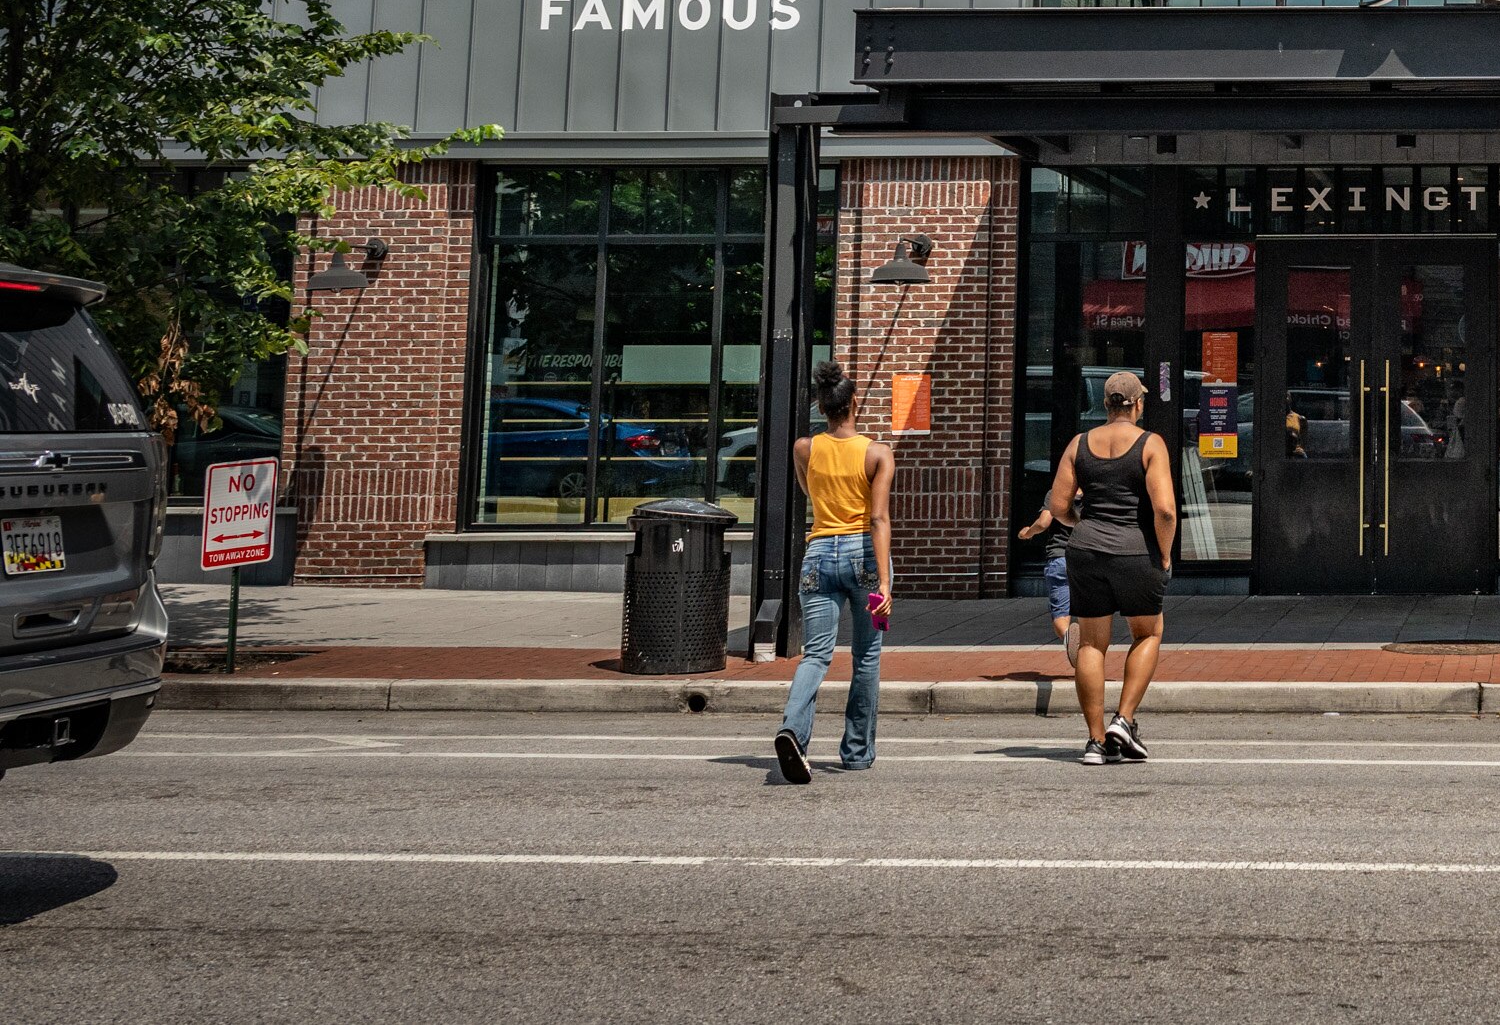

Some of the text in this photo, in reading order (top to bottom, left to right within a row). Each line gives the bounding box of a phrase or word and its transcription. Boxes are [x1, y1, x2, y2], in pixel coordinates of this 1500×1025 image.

[228, 474, 256, 492] NO
[210, 503, 269, 525] STOPPING
[209, 548, 265, 563] TOW AWAY ZONE
